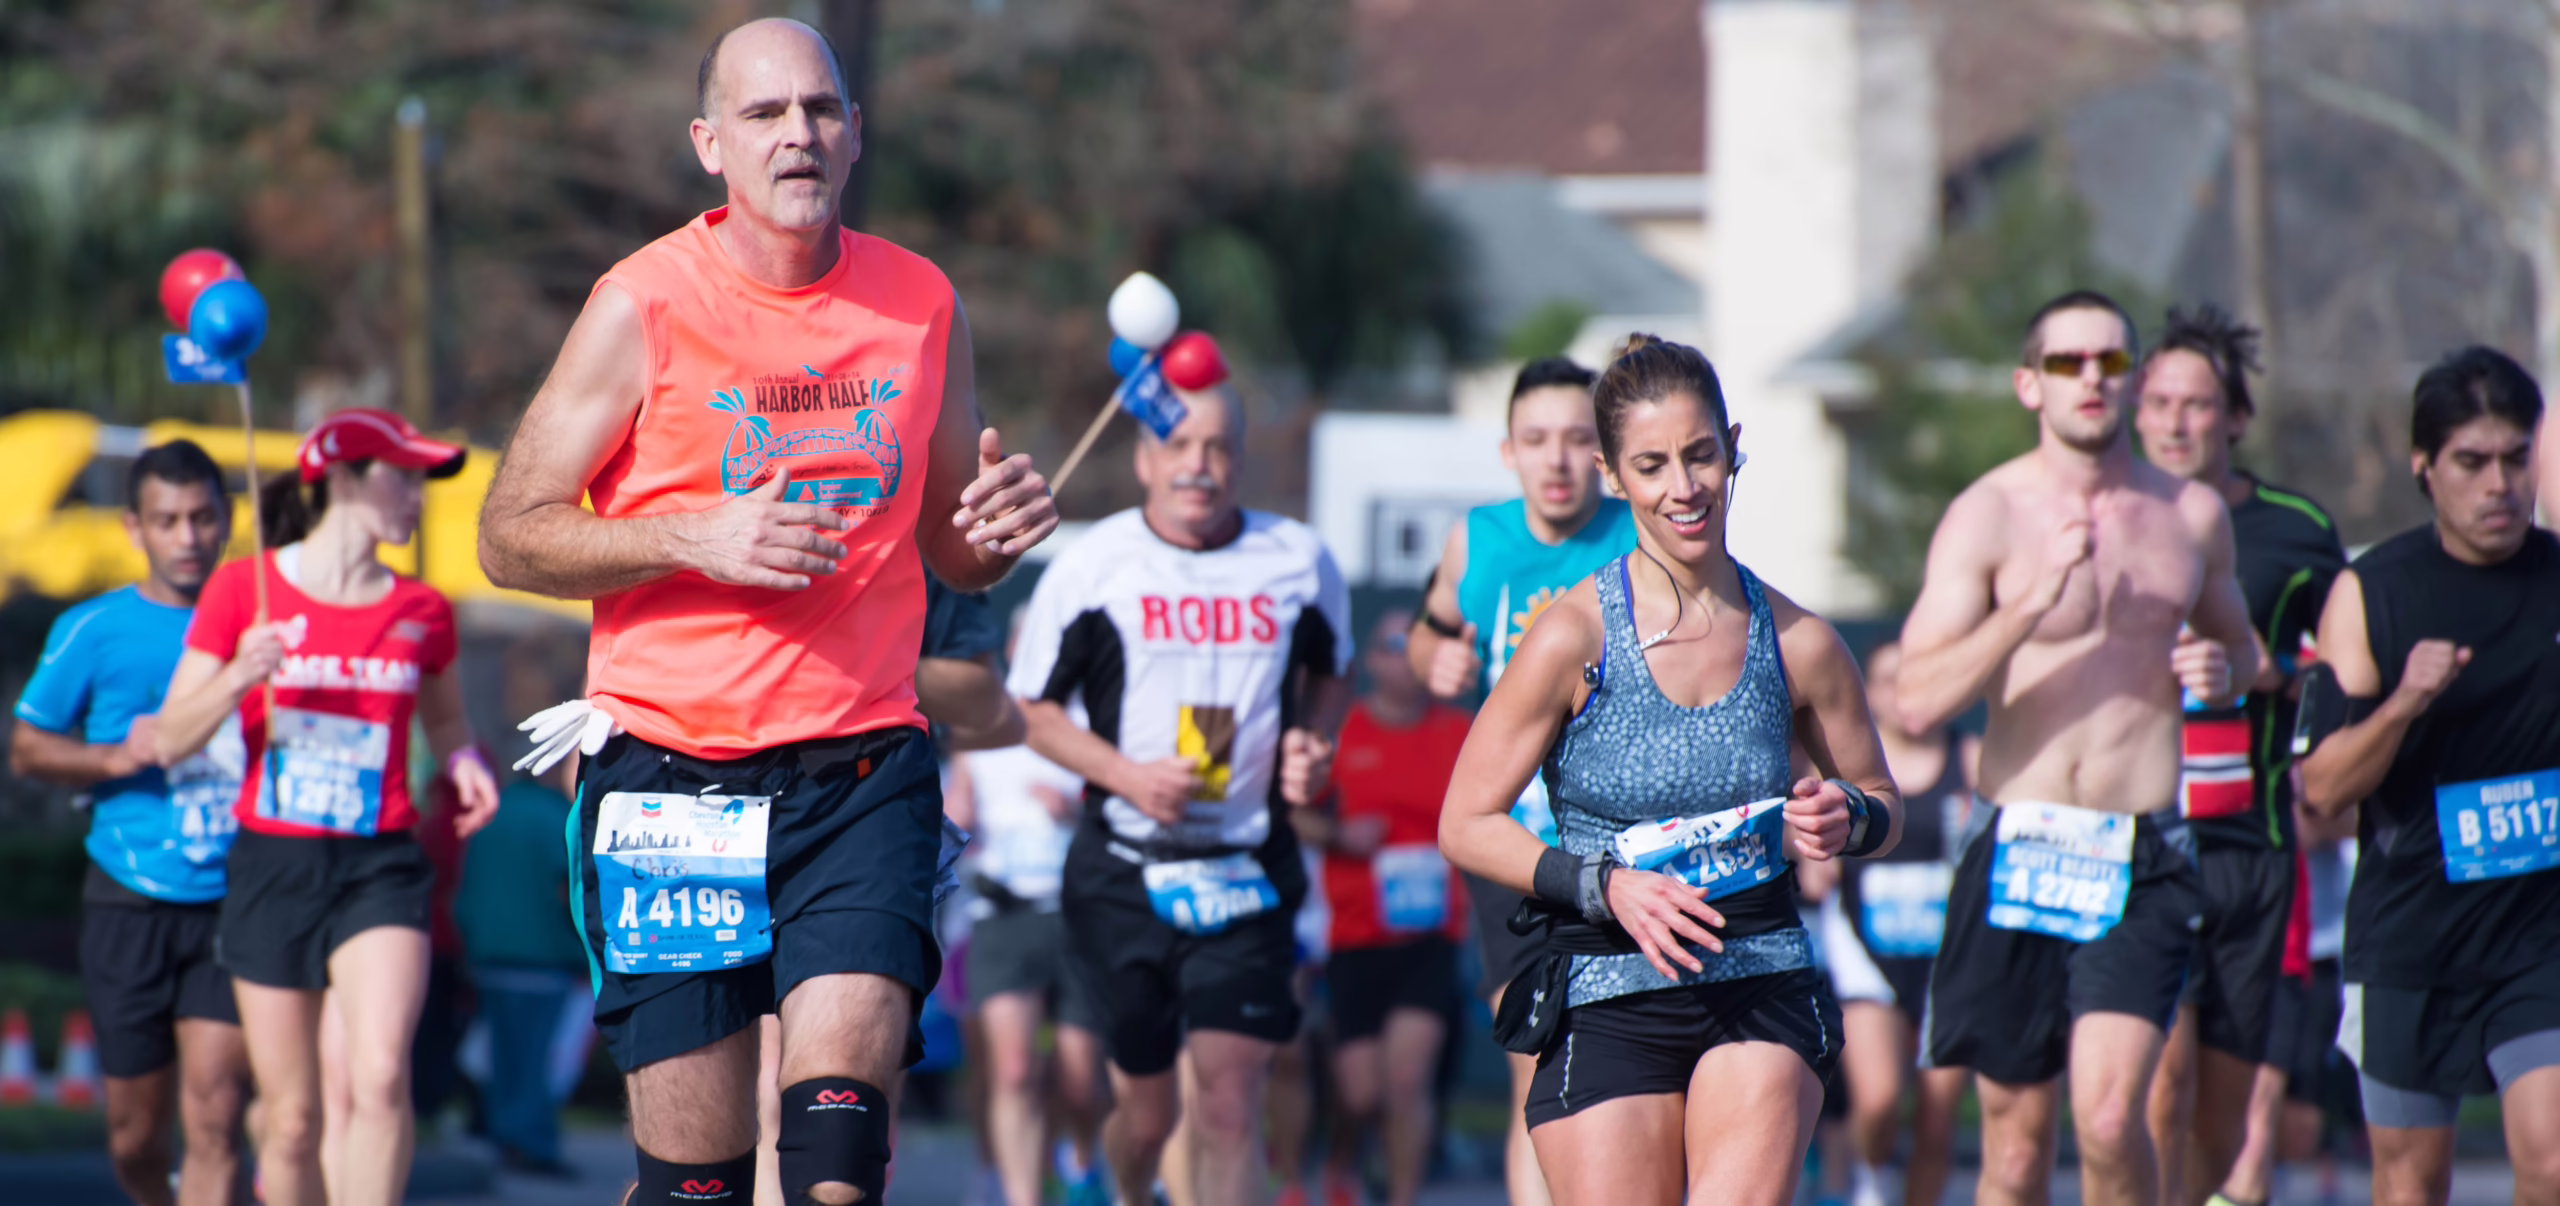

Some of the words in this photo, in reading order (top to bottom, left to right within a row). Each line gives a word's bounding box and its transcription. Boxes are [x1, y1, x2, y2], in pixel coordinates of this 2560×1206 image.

[752, 373, 773, 385] 10th
[754, 383, 825, 413] HARBOR
[828, 379, 870, 410] HALF
[1140, 593, 1279, 644] RODS
[2457, 808, 2482, 848] B
[2487, 797, 2559, 843] 5117
[631, 857, 690, 881] Chris
[2006, 866, 2030, 904] A
[617, 886, 640, 929] A
[648, 886, 745, 928] 4196
[658, 953, 678, 961] GEAR
[679, 951, 702, 960] CHECK
[723, 950, 743, 958] FOOD
